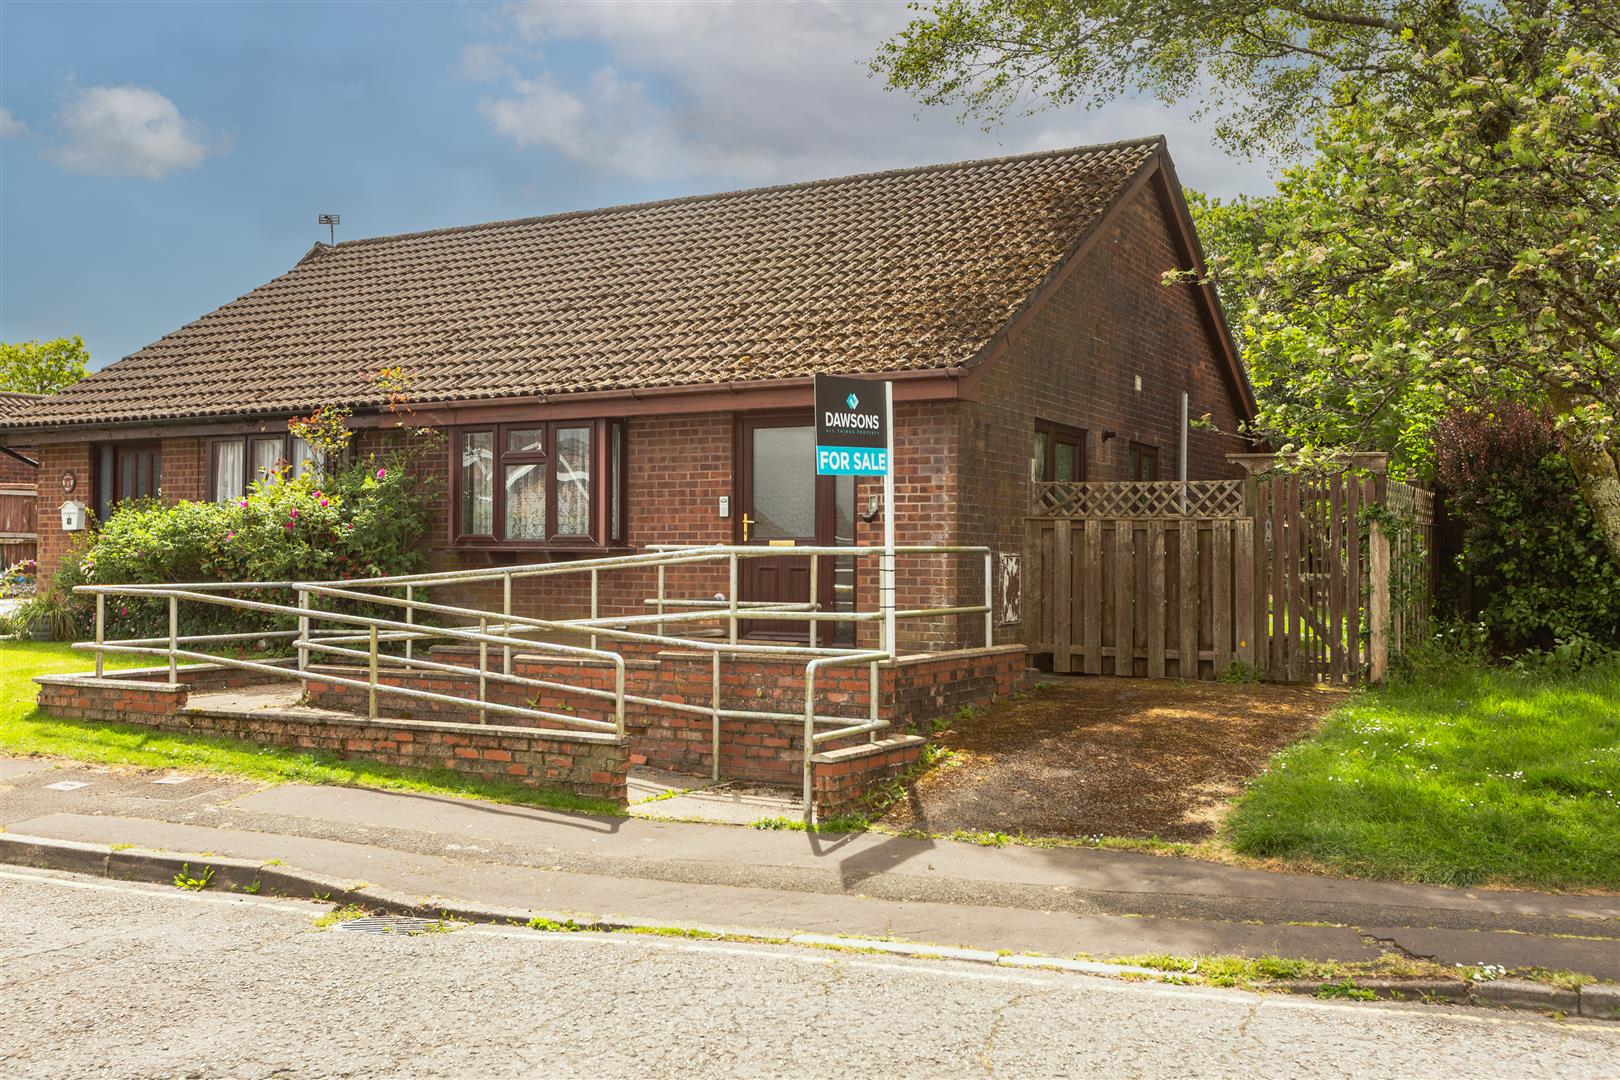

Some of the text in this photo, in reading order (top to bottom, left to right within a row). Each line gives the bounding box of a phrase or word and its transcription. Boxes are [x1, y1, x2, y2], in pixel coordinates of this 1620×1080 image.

[825, 411, 880, 429] DAWSONS
[820, 451, 886, 470] FOR SALE
